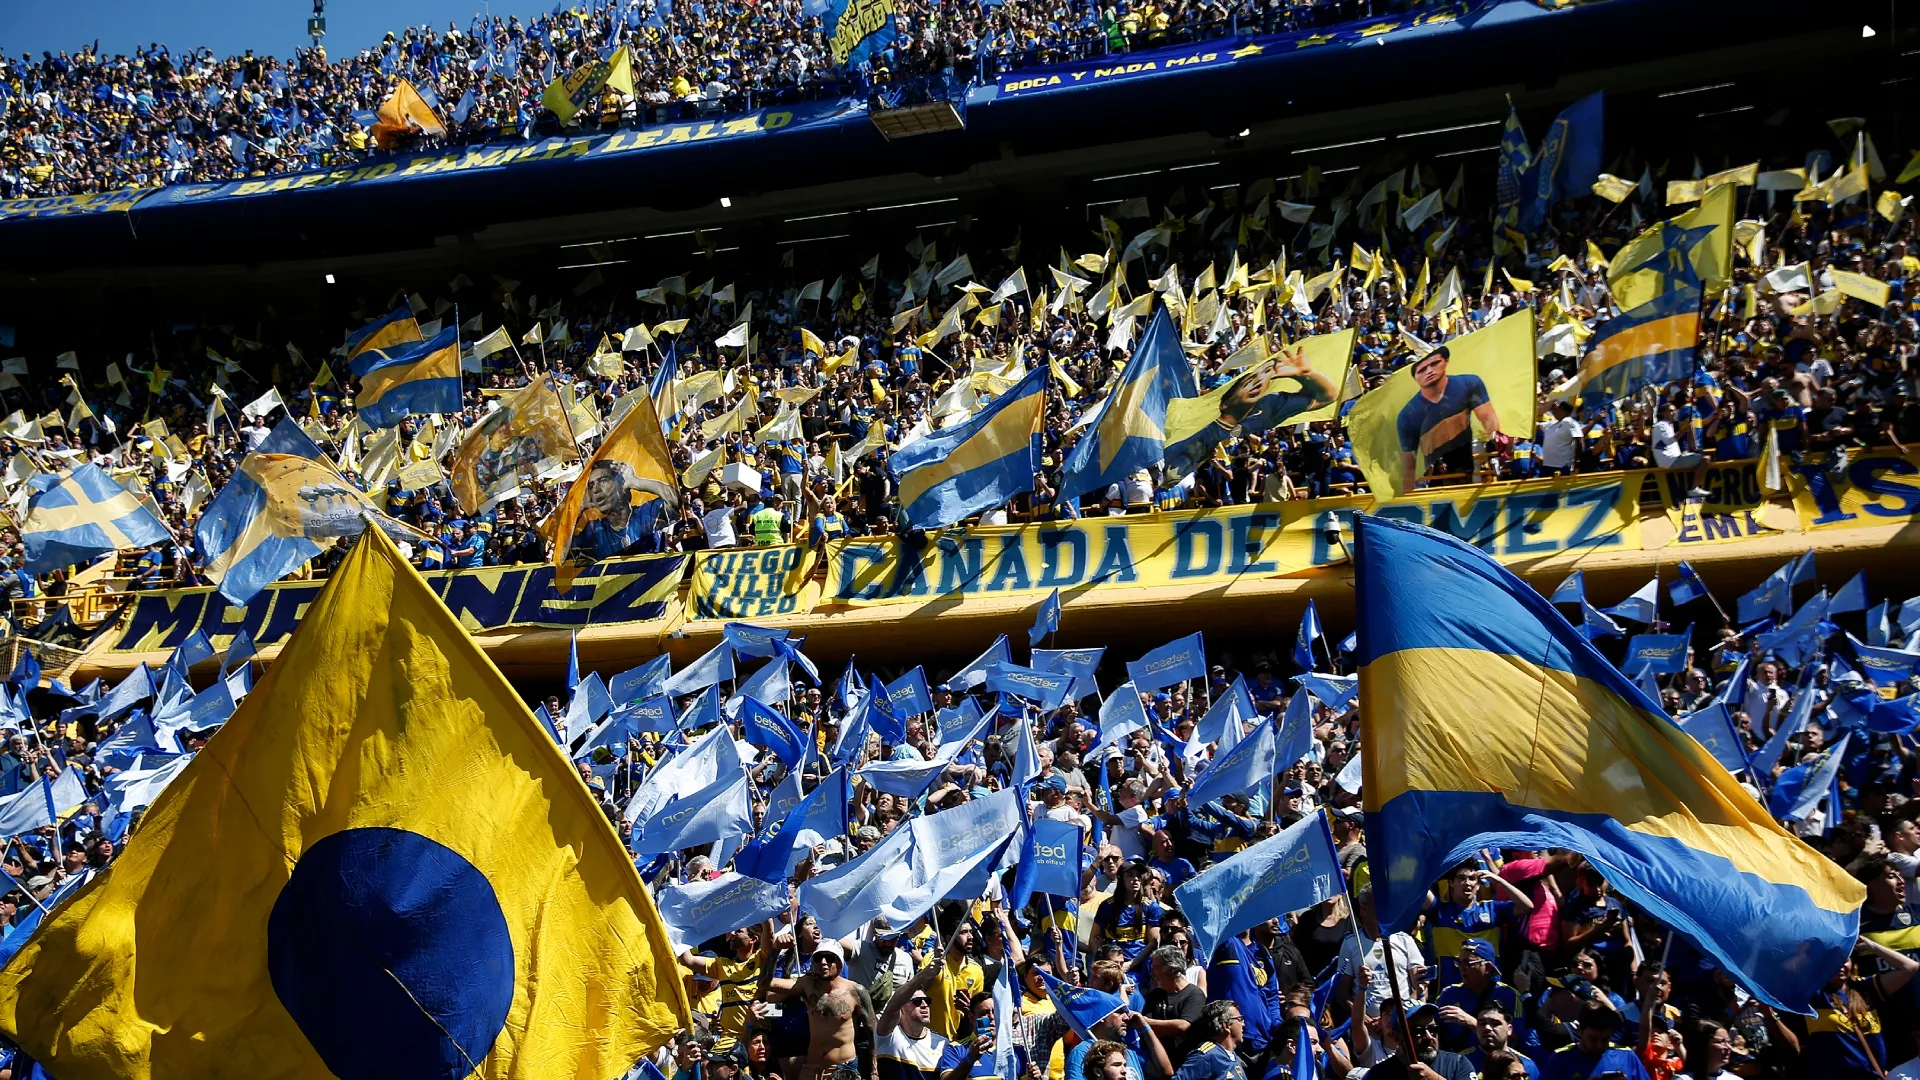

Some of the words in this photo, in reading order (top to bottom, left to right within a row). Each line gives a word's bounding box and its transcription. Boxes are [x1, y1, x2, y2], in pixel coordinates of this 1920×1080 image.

[1004, 75, 1062, 93] BOCA
[1071, 71, 1087, 82] Y
[1094, 62, 1157, 78] NADA
[703, 546, 803, 575] DIEGO
[1170, 511, 1281, 580] DE
[708, 573, 785, 598] PILU
[754, 711, 792, 742] betsson
